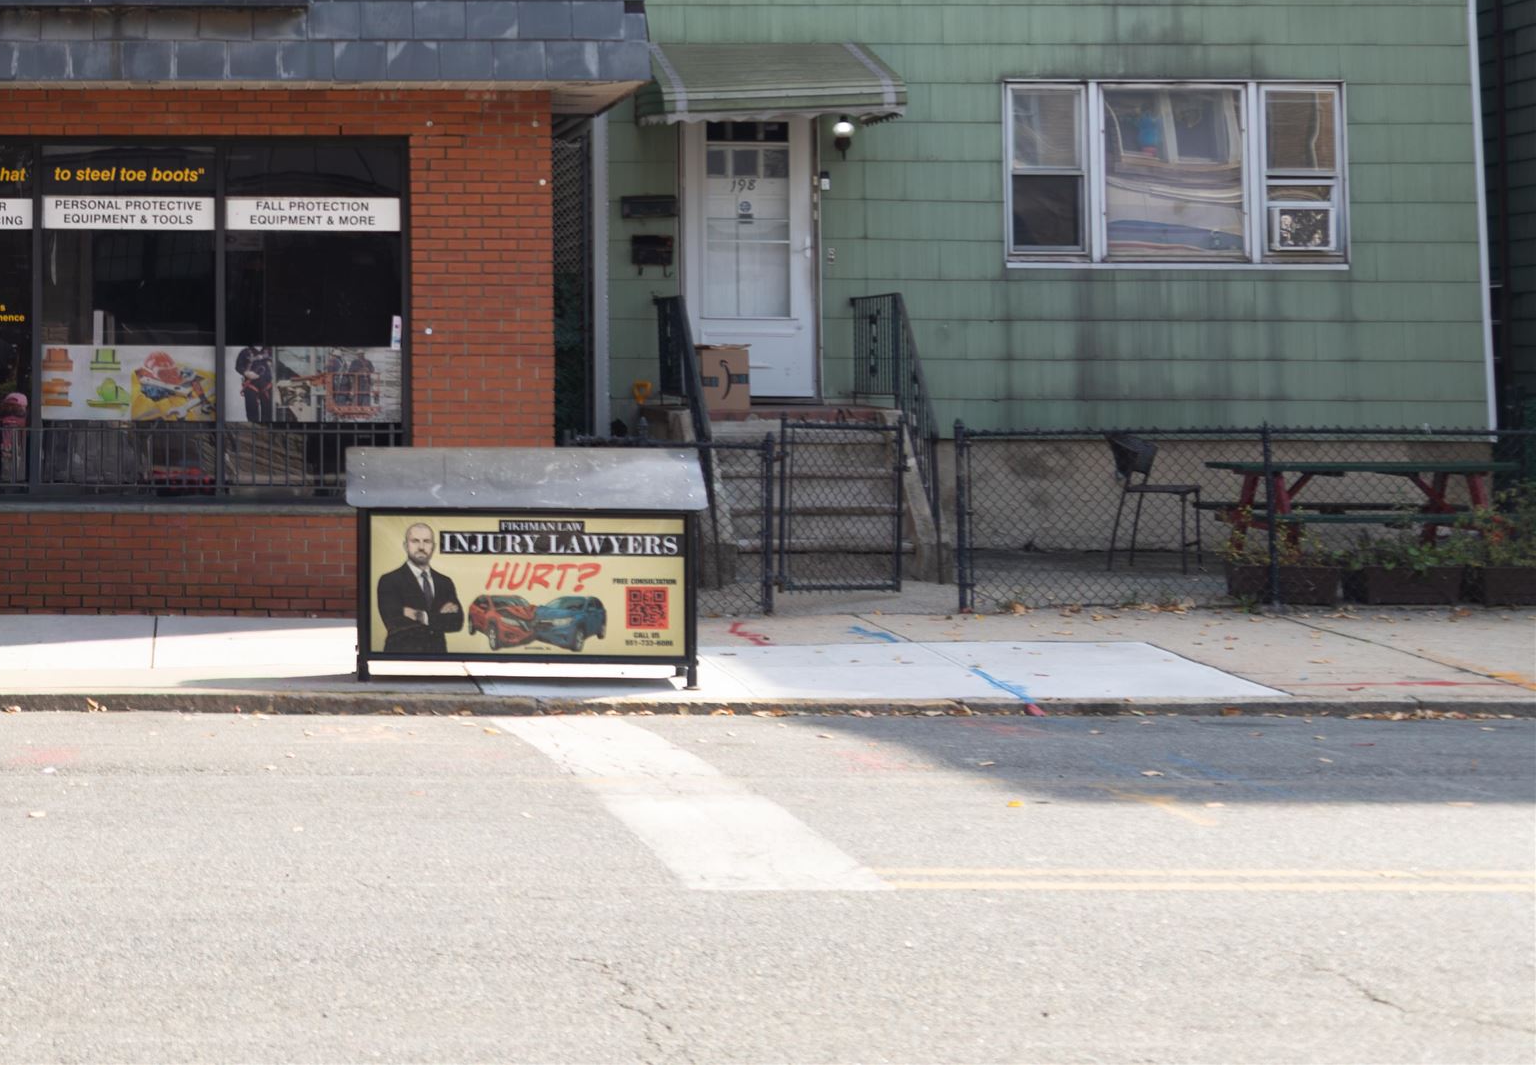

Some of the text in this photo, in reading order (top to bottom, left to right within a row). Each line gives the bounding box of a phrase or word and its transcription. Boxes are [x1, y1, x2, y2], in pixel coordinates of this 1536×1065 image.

[0, 167, 26, 182] hat
[53, 167, 205, 183] to steel toe boots"
[730, 178, 757, 193] 198
[54, 199, 203, 212] PERSONAL PROTECTIVE
[255, 200, 370, 213] FALL PROTECTION
[63, 213, 194, 226] EQUIPMENT & TOOLS
[249, 214, 376, 226] EQUIPMENT & MORE
[500, 521, 583, 532] FIKHMAN LAW
[442, 532, 678, 555] INJURY LAWYERS
[485, 560, 602, 593] HURT?
